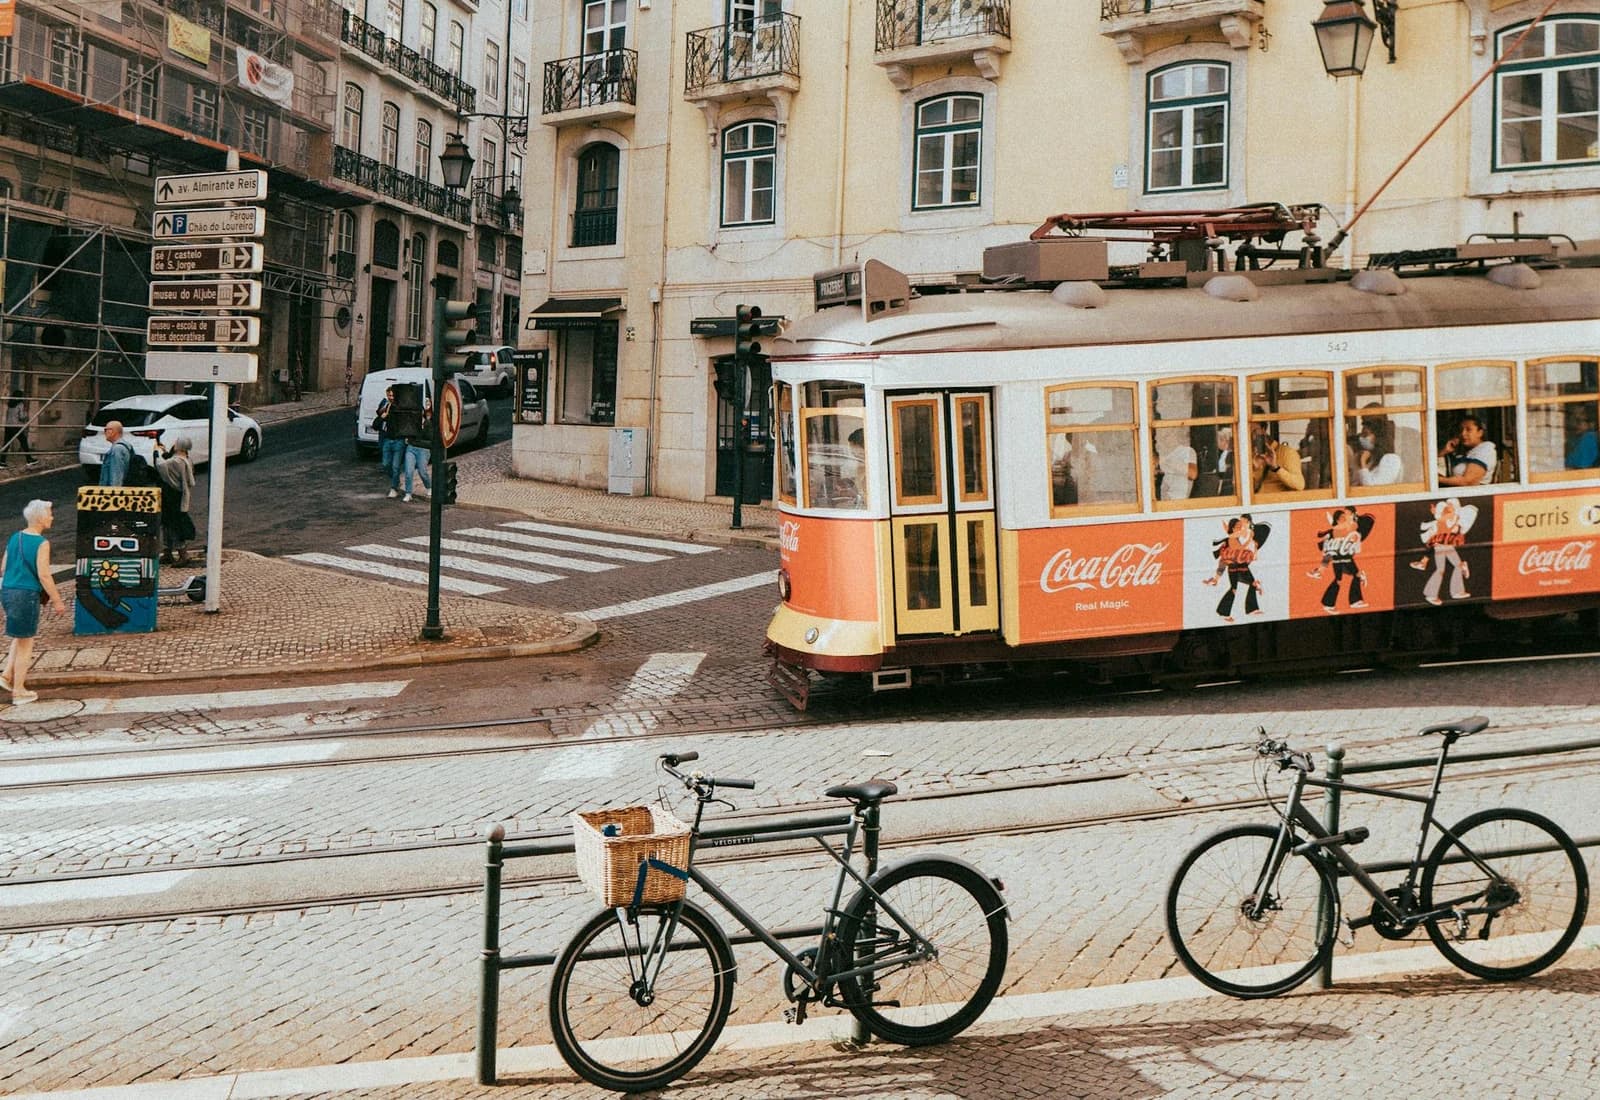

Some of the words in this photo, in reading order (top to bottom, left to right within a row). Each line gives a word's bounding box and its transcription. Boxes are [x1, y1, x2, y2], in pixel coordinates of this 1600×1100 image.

[178, 185, 190, 194] av.
[192, 180, 235, 193] Almirante
[238, 178, 257, 190] Reis
[230, 211, 254, 223] Parque
[188, 222, 207, 232] Chão
[210, 221, 220, 232] do
[222, 221, 254, 231] Loureiro
[174, 250, 202, 259] castelo
[155, 262, 165, 270] de
[167, 261, 175, 270] S.
[153, 290, 177, 300] museu
[181, 289, 191, 299] do
[193, 288, 217, 301] Aljube
[151, 322, 171, 331] museu
[176, 321, 197, 330] escola
[199, 321, 208, 330] de
[151, 333, 167, 341] artes
[169, 332, 205, 342] decorativas
[1327, 341, 1348, 353] 542
[1514, 506, 1569, 529] carris
[1518, 540, 1596, 575] Coca-Cola
[1039, 541, 1170, 593] Coca-Cola
[1075, 602, 1097, 612] Real
[1100, 599, 1130, 610] Magic
[713, 836, 754, 847] VELORETTI
